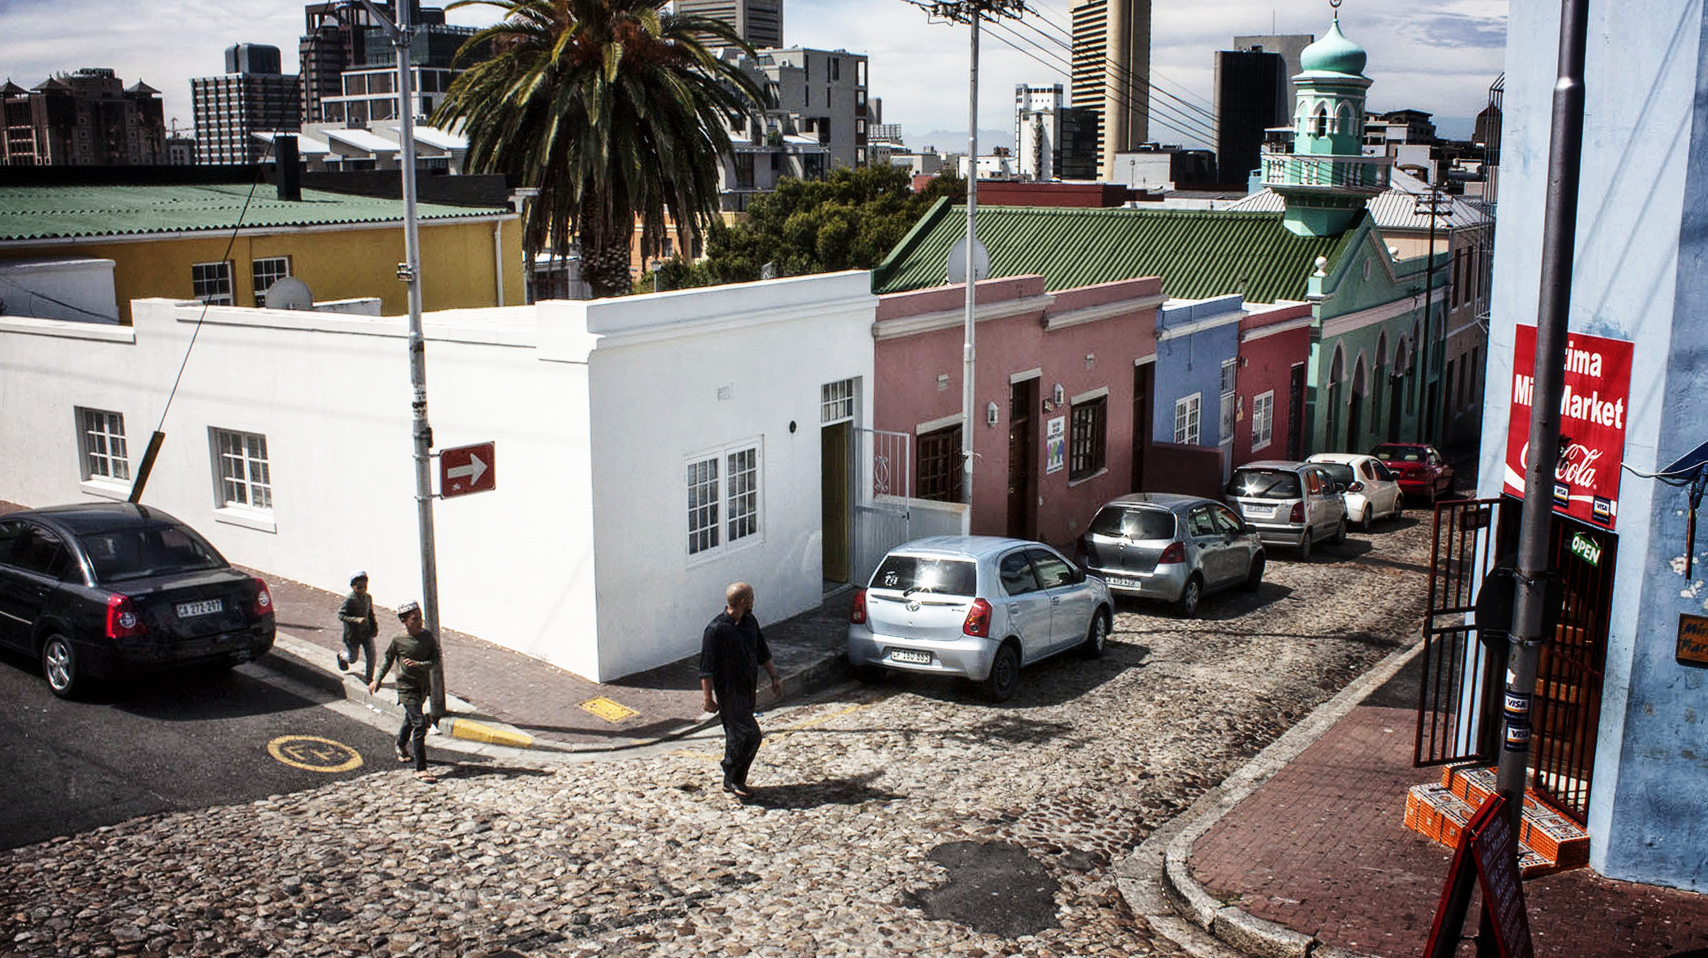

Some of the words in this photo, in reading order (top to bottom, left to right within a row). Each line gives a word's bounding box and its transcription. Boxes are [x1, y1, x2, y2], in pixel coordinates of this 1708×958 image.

[1514, 374, 1534, 407] Mi
[1560, 385, 1624, 430] Market
[1572, 536, 1601, 564] OPEN
[1507, 698, 1527, 708] VISA
